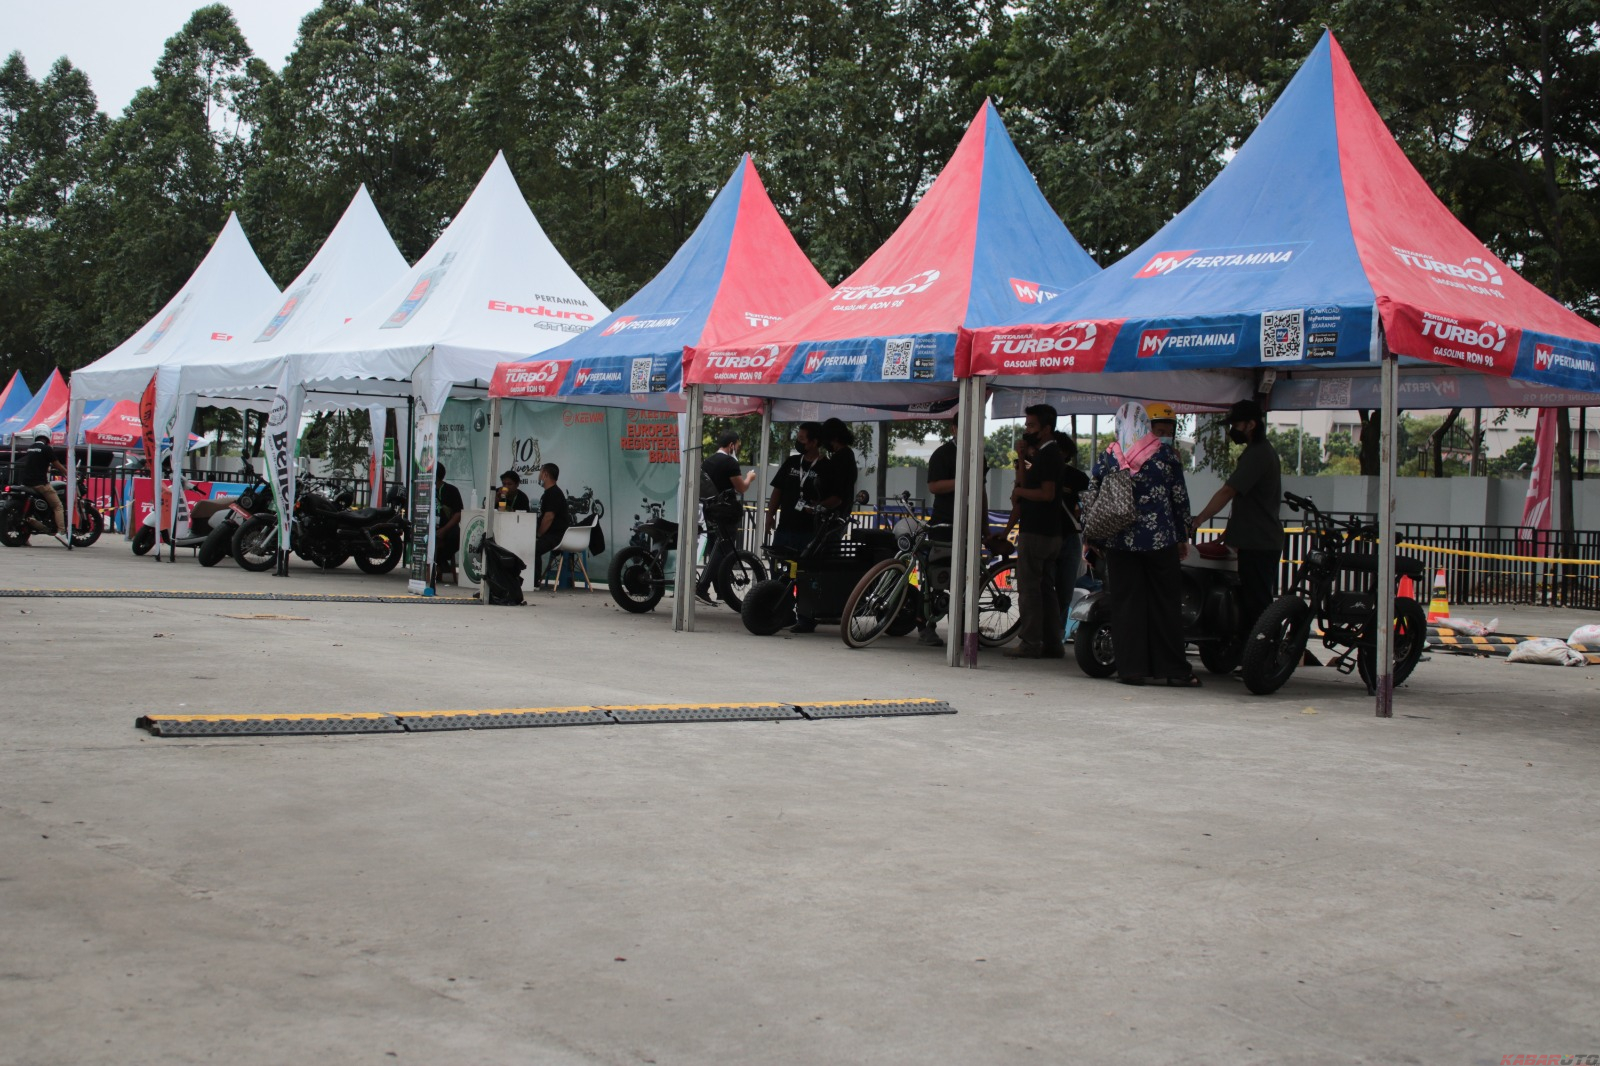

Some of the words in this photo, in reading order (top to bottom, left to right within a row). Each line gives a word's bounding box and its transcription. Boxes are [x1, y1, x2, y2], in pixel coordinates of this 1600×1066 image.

[1394, 251, 1488, 282] TURBO
[830, 284, 917, 301] TURBO
[534, 293, 589, 308] PERTAMINA
[868, 301, 891, 310] RON
[891, 300, 905, 308] 98
[488, 300, 594, 321] Enduro
[1424, 311, 1458, 325] PERTAMAX
[1422, 319, 1494, 349] TURBO
[990, 337, 1078, 354] TURBO
[706, 355, 766, 368] TURBO
[1004, 360, 1037, 368] GASOLINE
[1040, 357, 1060, 368] RON
[1063, 356, 1075, 366] 98
[1433, 346, 1465, 360] GASOLINE
[1467, 352, 1483, 364] RON
[1485, 355, 1494, 367] 98
[505, 372, 547, 383] TURBO
[754, 371, 763, 379] 98
[574, 412, 605, 424] KEEWAY
[515, 438, 533, 462] 10
